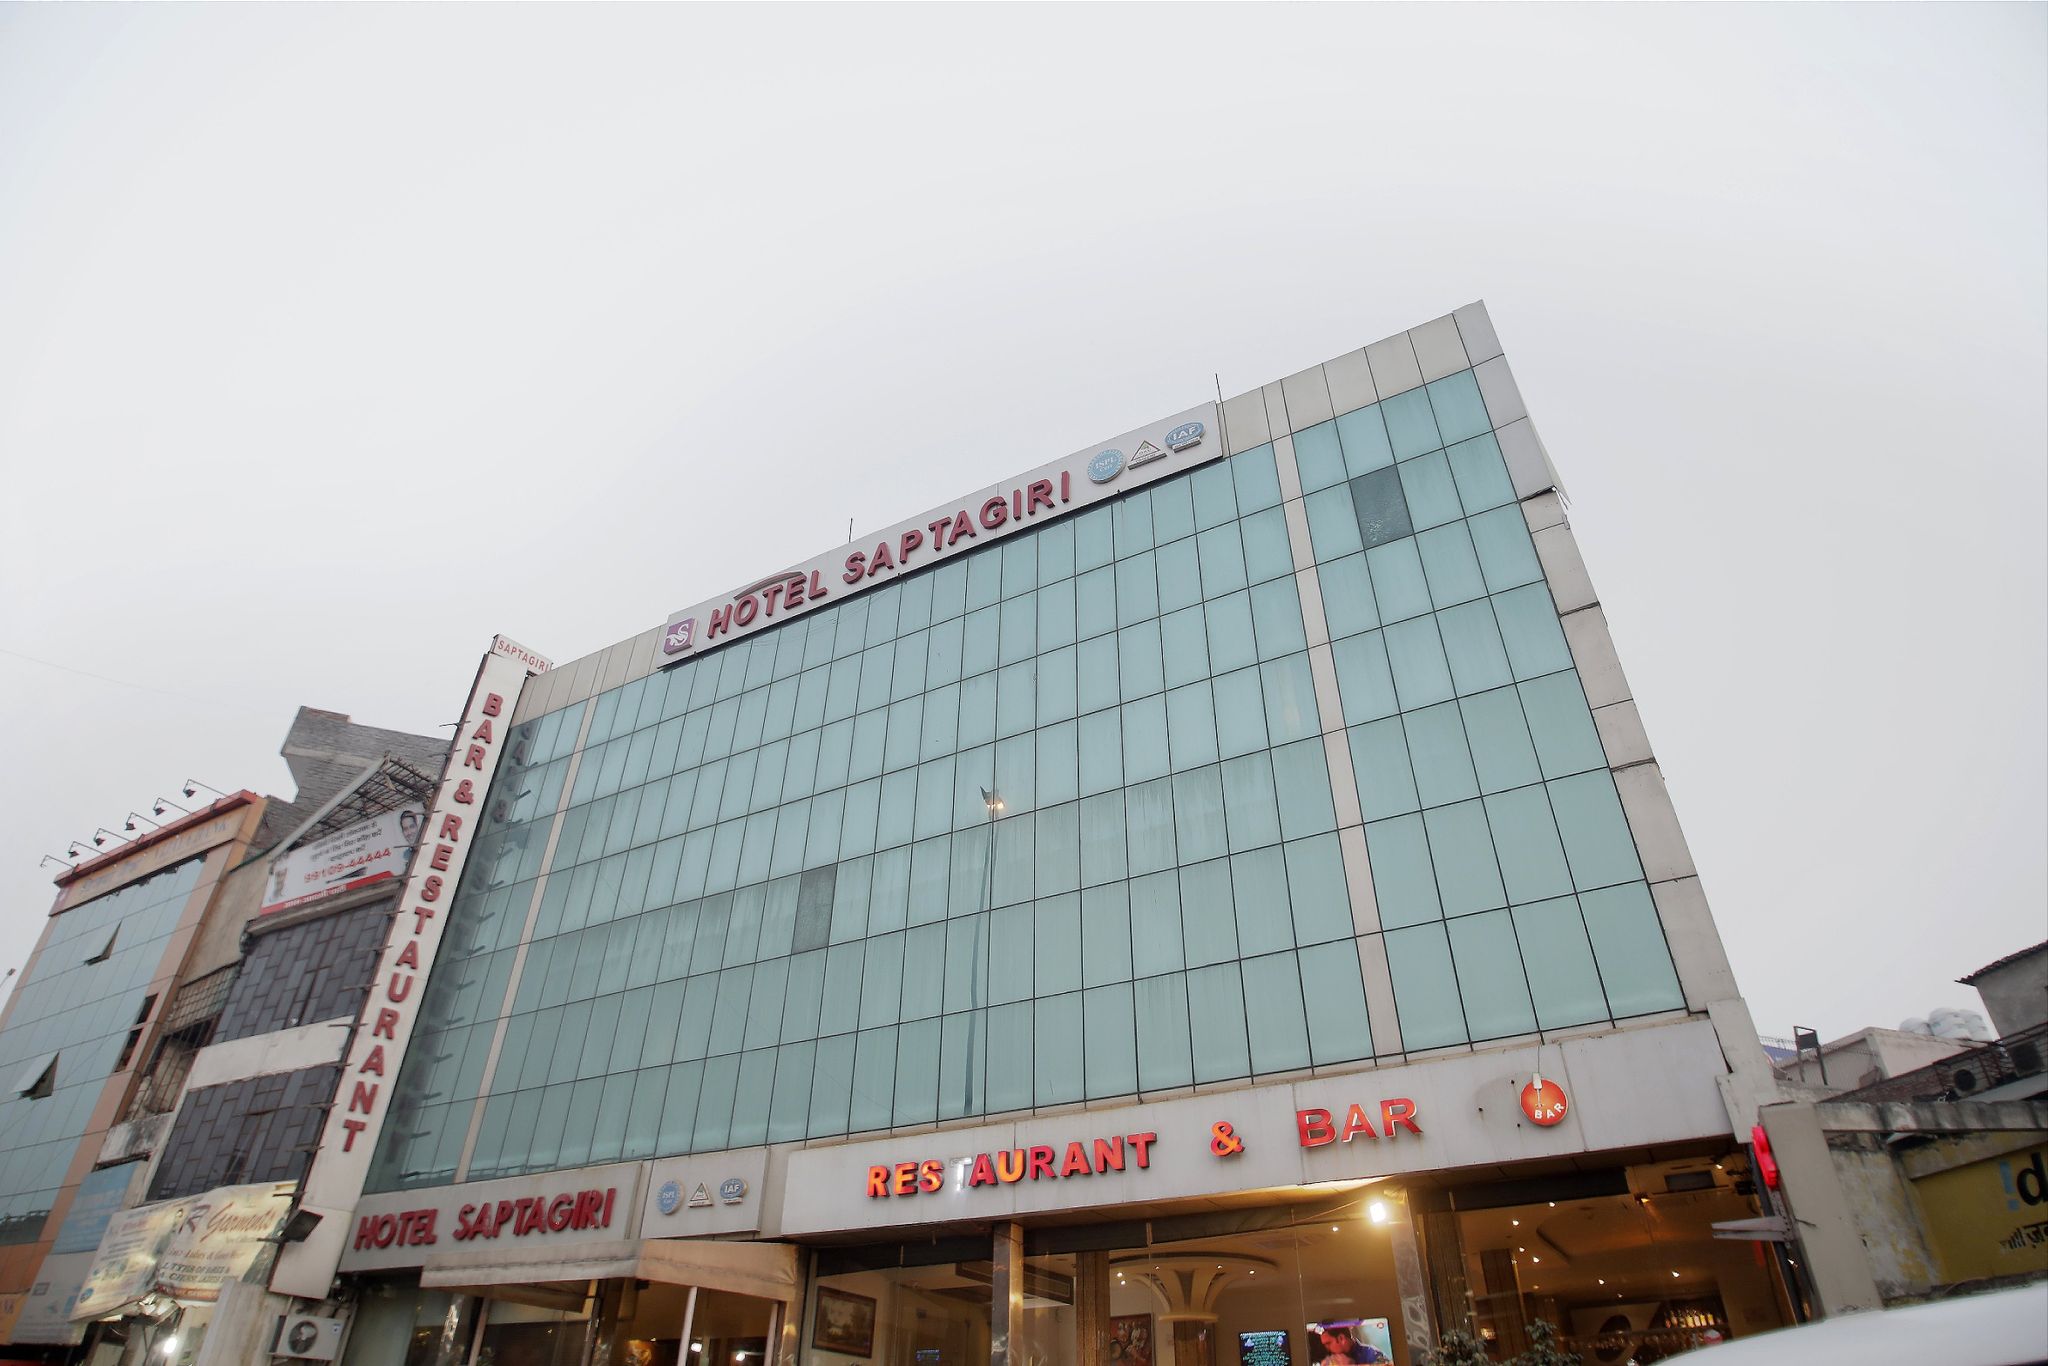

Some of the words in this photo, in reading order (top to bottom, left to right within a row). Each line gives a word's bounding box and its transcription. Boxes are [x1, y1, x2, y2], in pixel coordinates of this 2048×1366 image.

[1173, 426, 1197, 441] IAF
[707, 569, 828, 639] HOTEL
[842, 470, 1071, 585] SAPTAGIRI
[464, 692, 504, 770] BAR
[454, 778, 474, 805] &
[342, 813, 463, 1153] RESTAURANT
[1534, 1102, 1564, 1119] BAR
[866, 1131, 1158, 1199] RESTAURANT
[1209, 1120, 1246, 1158] &
[1295, 1097, 1425, 1148] BAR
[353, 1208, 438, 1250] HOTEL
[453, 1188, 617, 1241] SAPTAGIRI
